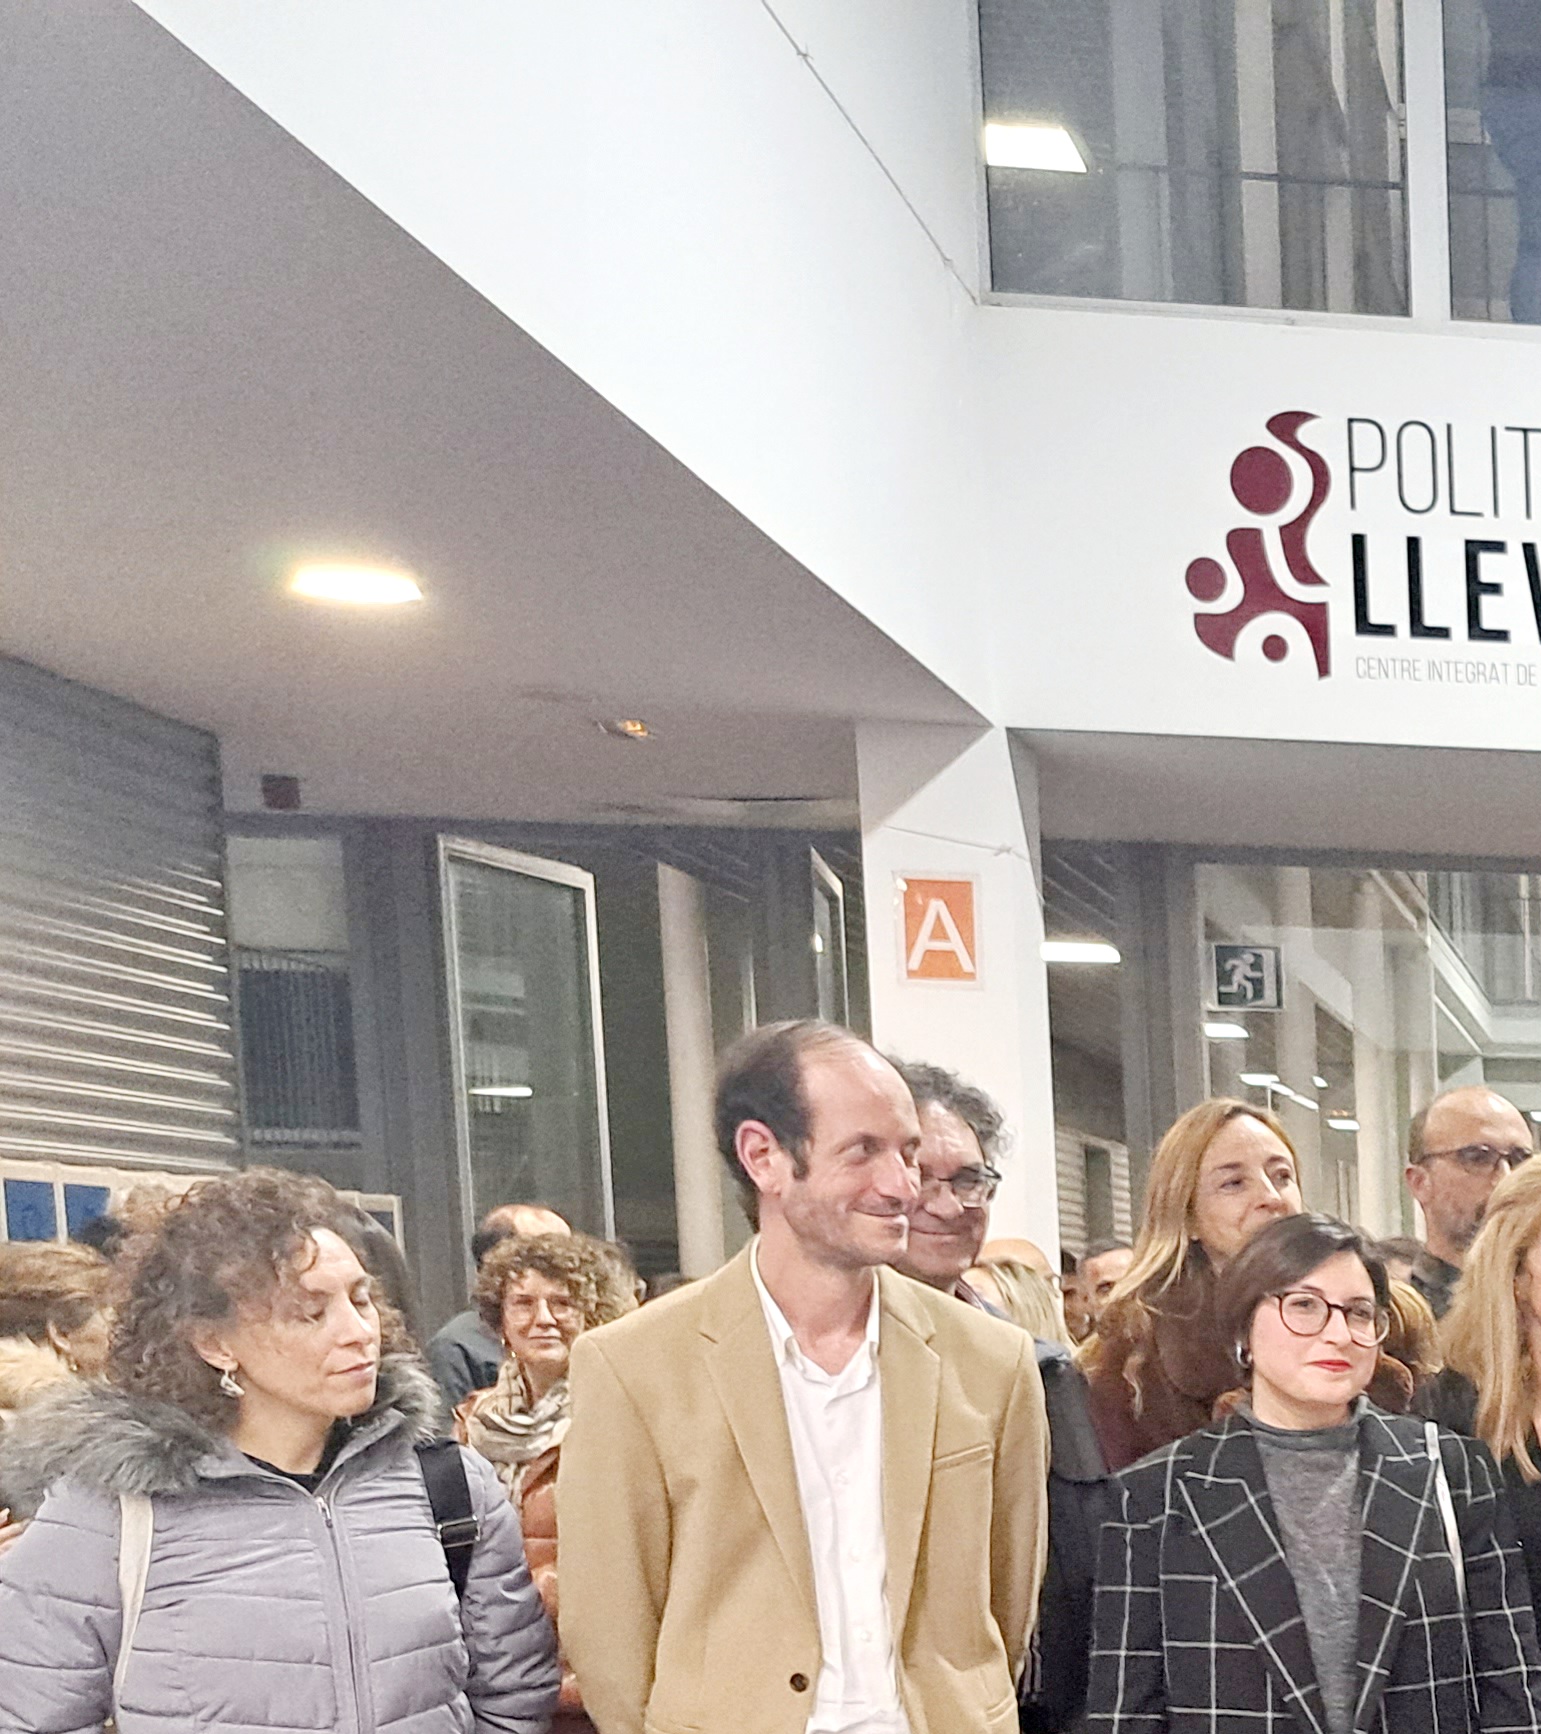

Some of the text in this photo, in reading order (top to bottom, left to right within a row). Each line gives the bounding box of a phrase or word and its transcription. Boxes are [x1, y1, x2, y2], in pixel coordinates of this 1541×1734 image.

[1355, 656, 1422, 681] CENTRE
[1427, 660, 1510, 685] INTEGRAT
[1516, 663, 1538, 687] DE
[907, 898, 975, 973] A
